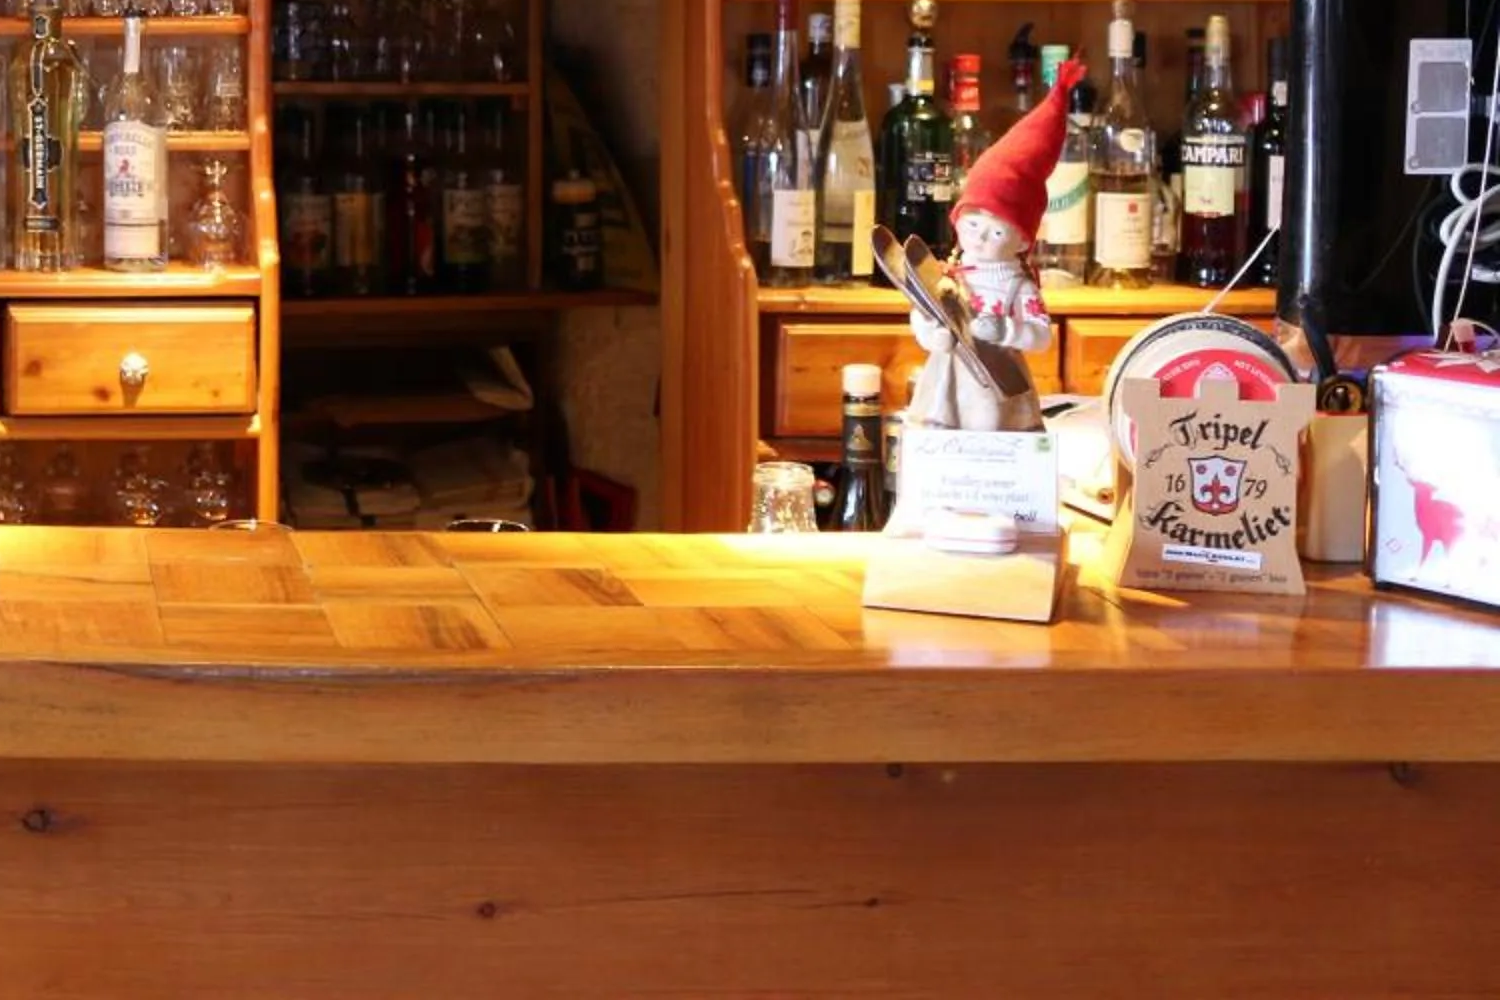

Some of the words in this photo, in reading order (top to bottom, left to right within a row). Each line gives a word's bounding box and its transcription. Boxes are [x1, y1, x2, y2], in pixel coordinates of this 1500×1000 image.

[1181, 144, 1244, 164] CAMPARI
[1169, 410, 1270, 451] Tripel
[1164, 473, 1186, 493] 16
[1244, 478, 1268, 499] 79
[1140, 500, 1291, 550] Karmeliet
